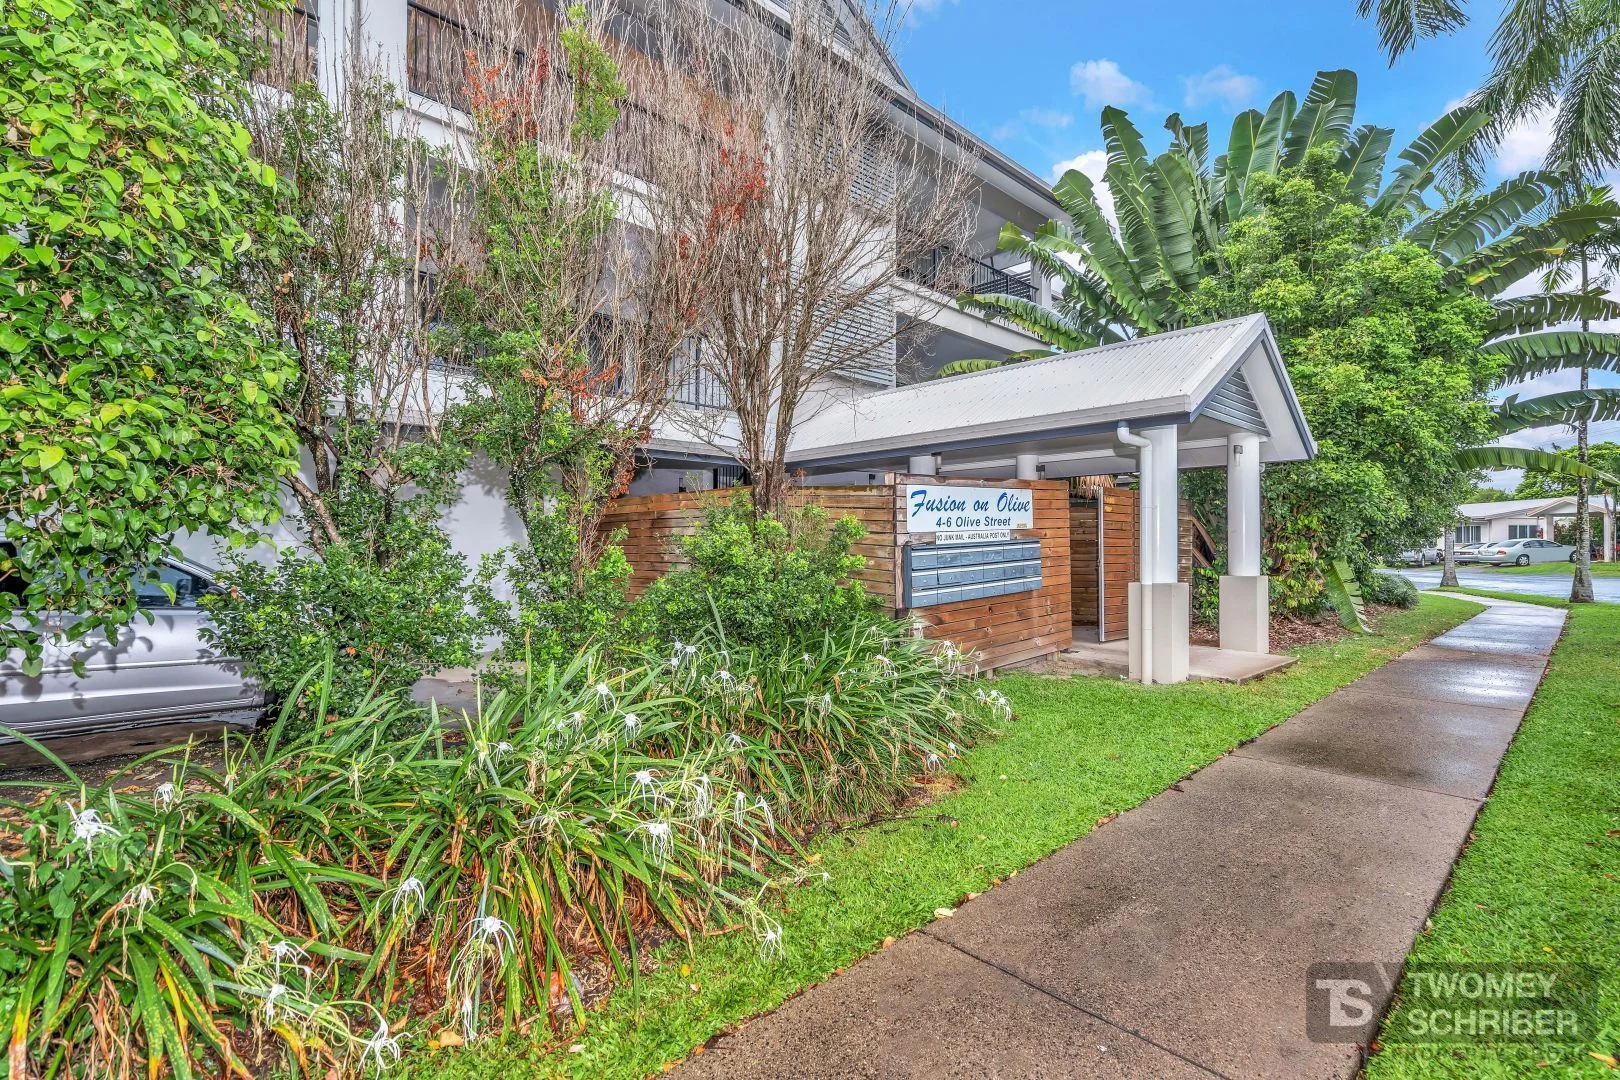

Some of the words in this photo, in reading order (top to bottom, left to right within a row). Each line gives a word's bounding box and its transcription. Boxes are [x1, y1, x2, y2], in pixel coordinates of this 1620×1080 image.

[910, 490, 967, 518] Fusion
[973, 500, 990, 512] on
[997, 491, 1031, 512] Olive
[935, 517, 952, 528] 4-6
[955, 516, 981, 528] Olive
[983, 515, 1011, 527] Street
[943, 533, 955, 541] JUNK
[955, 533, 965, 541] MAIL
[967, 532, 989, 540] AUSTRALIA
[989, 531, 1000, 539] POST
